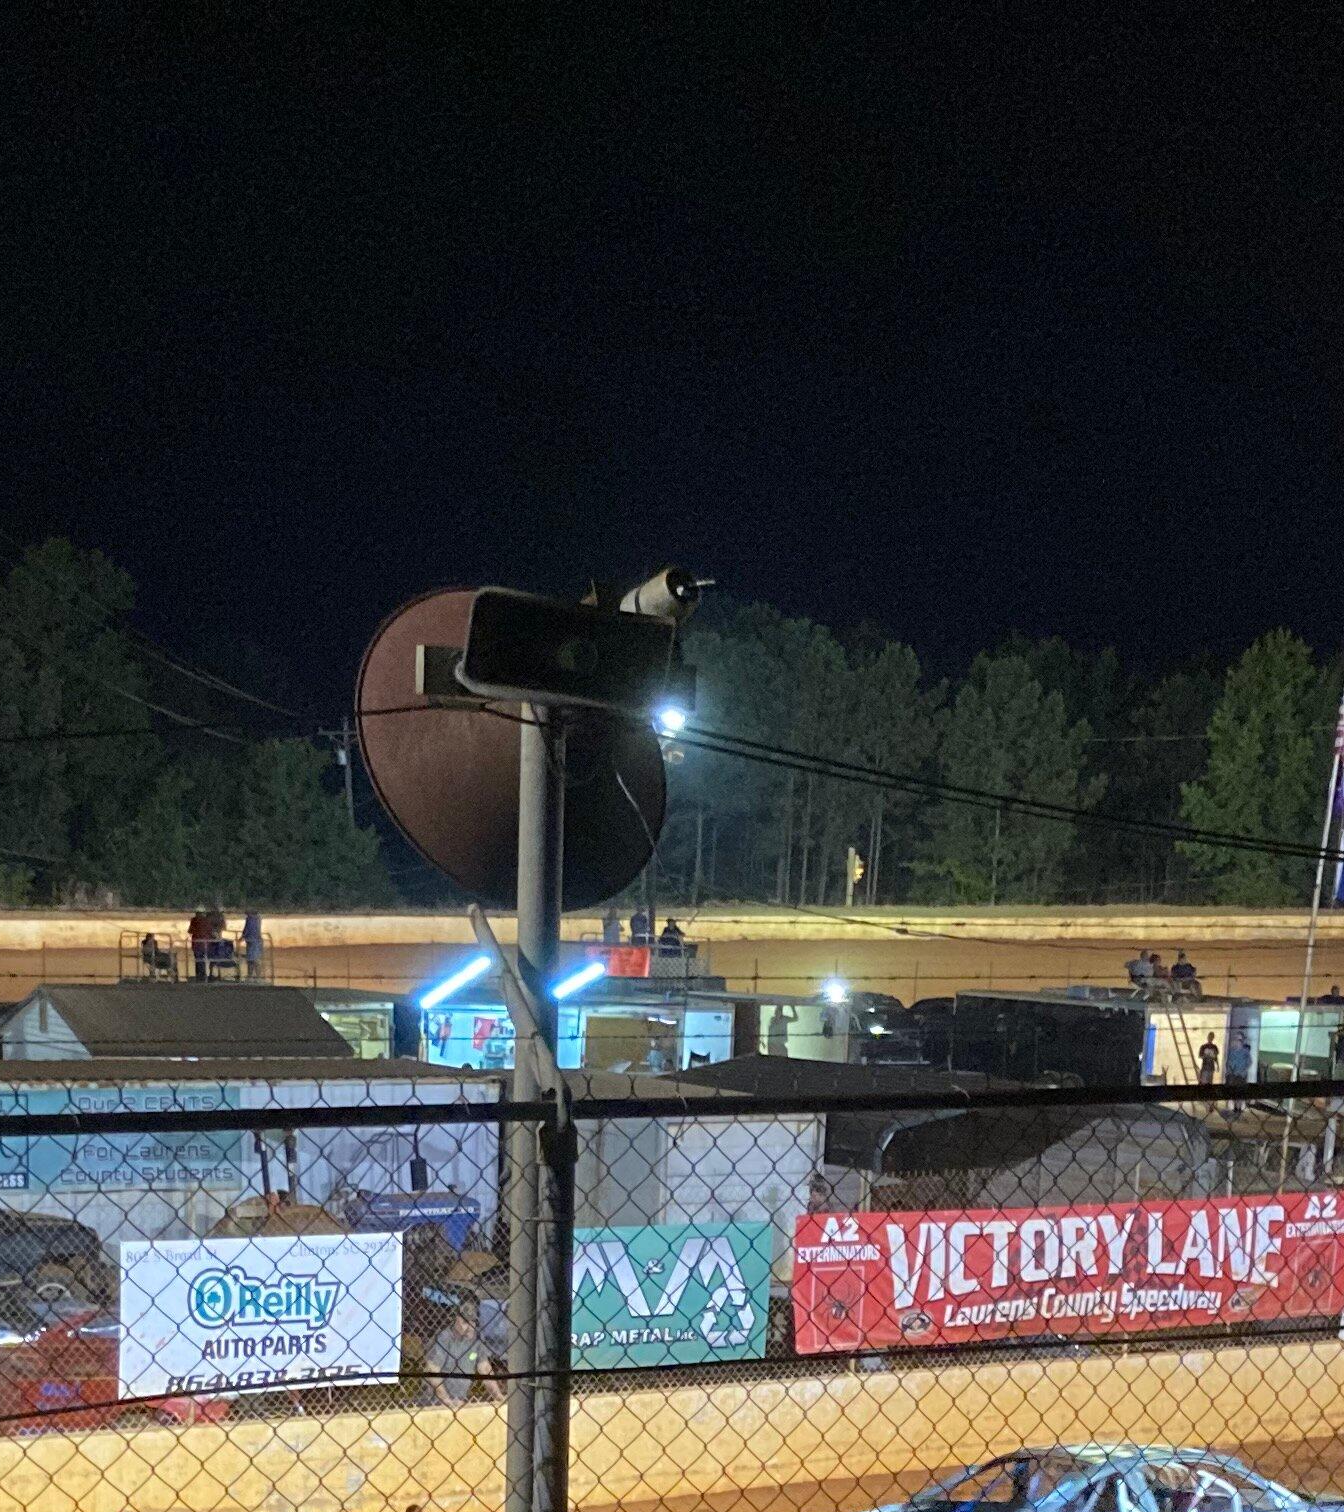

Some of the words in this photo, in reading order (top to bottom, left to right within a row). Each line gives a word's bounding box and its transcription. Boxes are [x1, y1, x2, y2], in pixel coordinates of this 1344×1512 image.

[144, 1096, 215, 1110] CENTS
[83, 1145, 114, 1162] For
[125, 1144, 211, 1161] Laurens
[60, 1169, 134, 1186] County
[142, 1167, 233, 1183] Students
[1305, 1194, 1338, 1220] A2
[821, 1215, 860, 1243] A2
[342, 1242, 361, 1255] SC
[797, 1244, 882, 1264] EXTERMINATORS
[886, 1212, 1136, 1310] VICTORY
[1145, 1205, 1285, 1288] LANE
[193, 1271, 336, 1326] O'Reilly
[944, 1295, 1038, 1328] Laurens
[1040, 1287, 1118, 1324] County
[1119, 1281, 1223, 1321] Speedway
[203, 1337, 256, 1360] AUTO
[261, 1333, 327, 1357] PARTS
[610, 1327, 674, 1345] METAL
